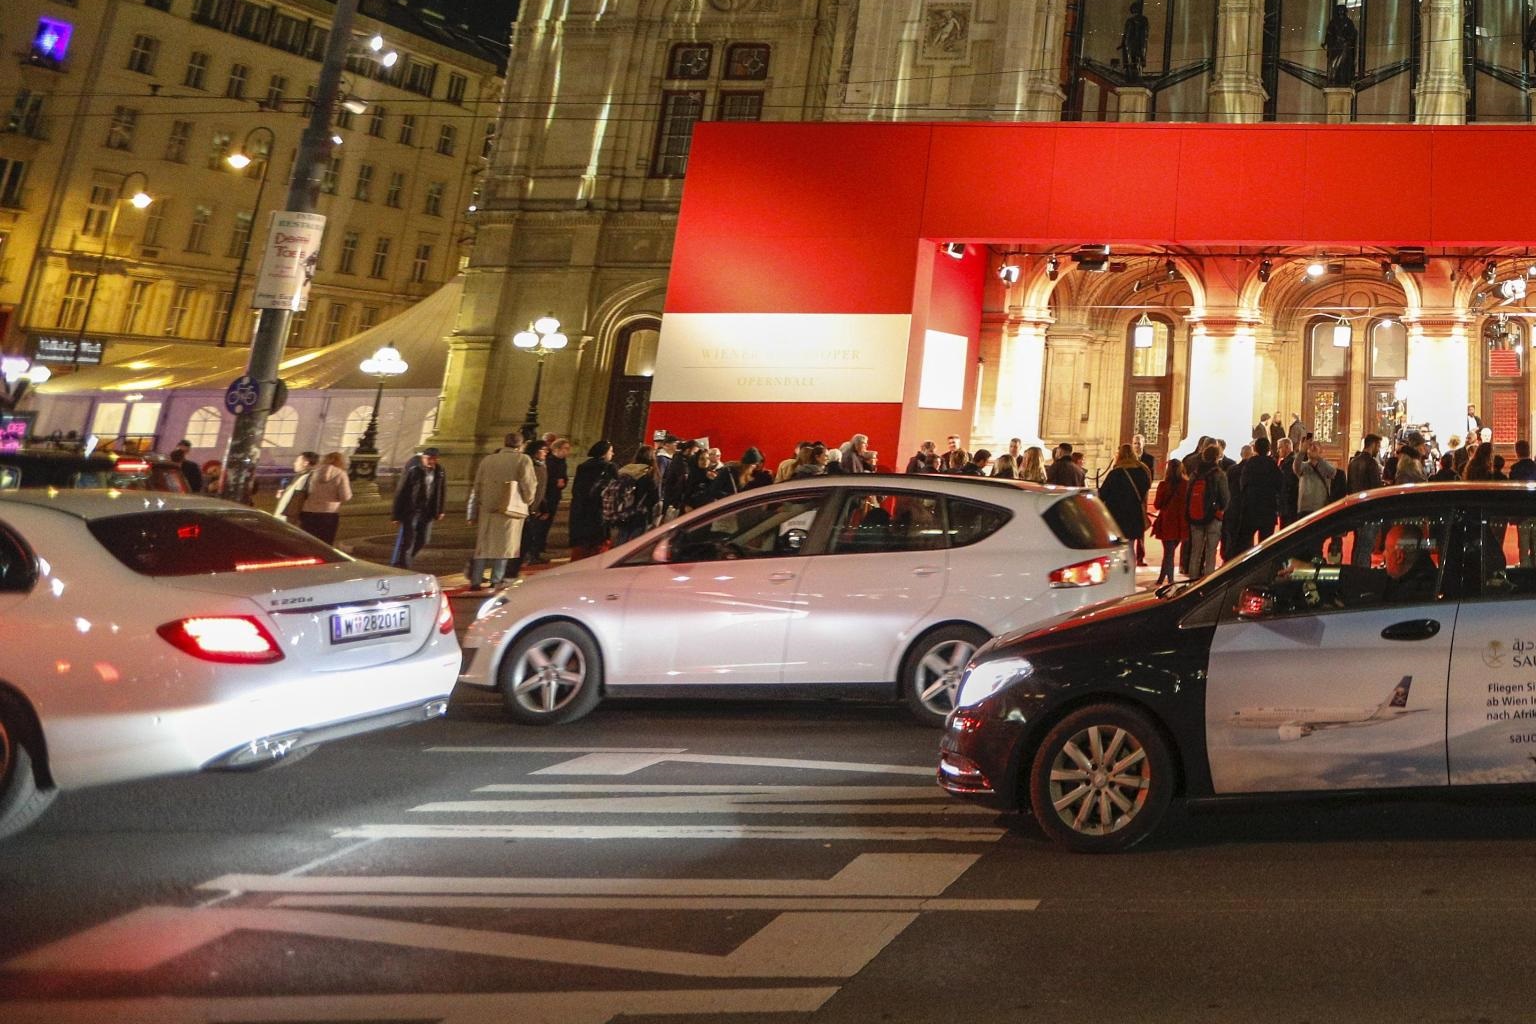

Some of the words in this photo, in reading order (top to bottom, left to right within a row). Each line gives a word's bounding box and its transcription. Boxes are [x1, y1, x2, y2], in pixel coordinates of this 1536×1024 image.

[736, 376, 816, 386] OPERNBALL
[1488, 682, 1524, 695] Fliegen
[1486, 696, 1499, 707] ab
[1502, 696, 1528, 706] Wien
[1486, 710, 1510, 721] nach
